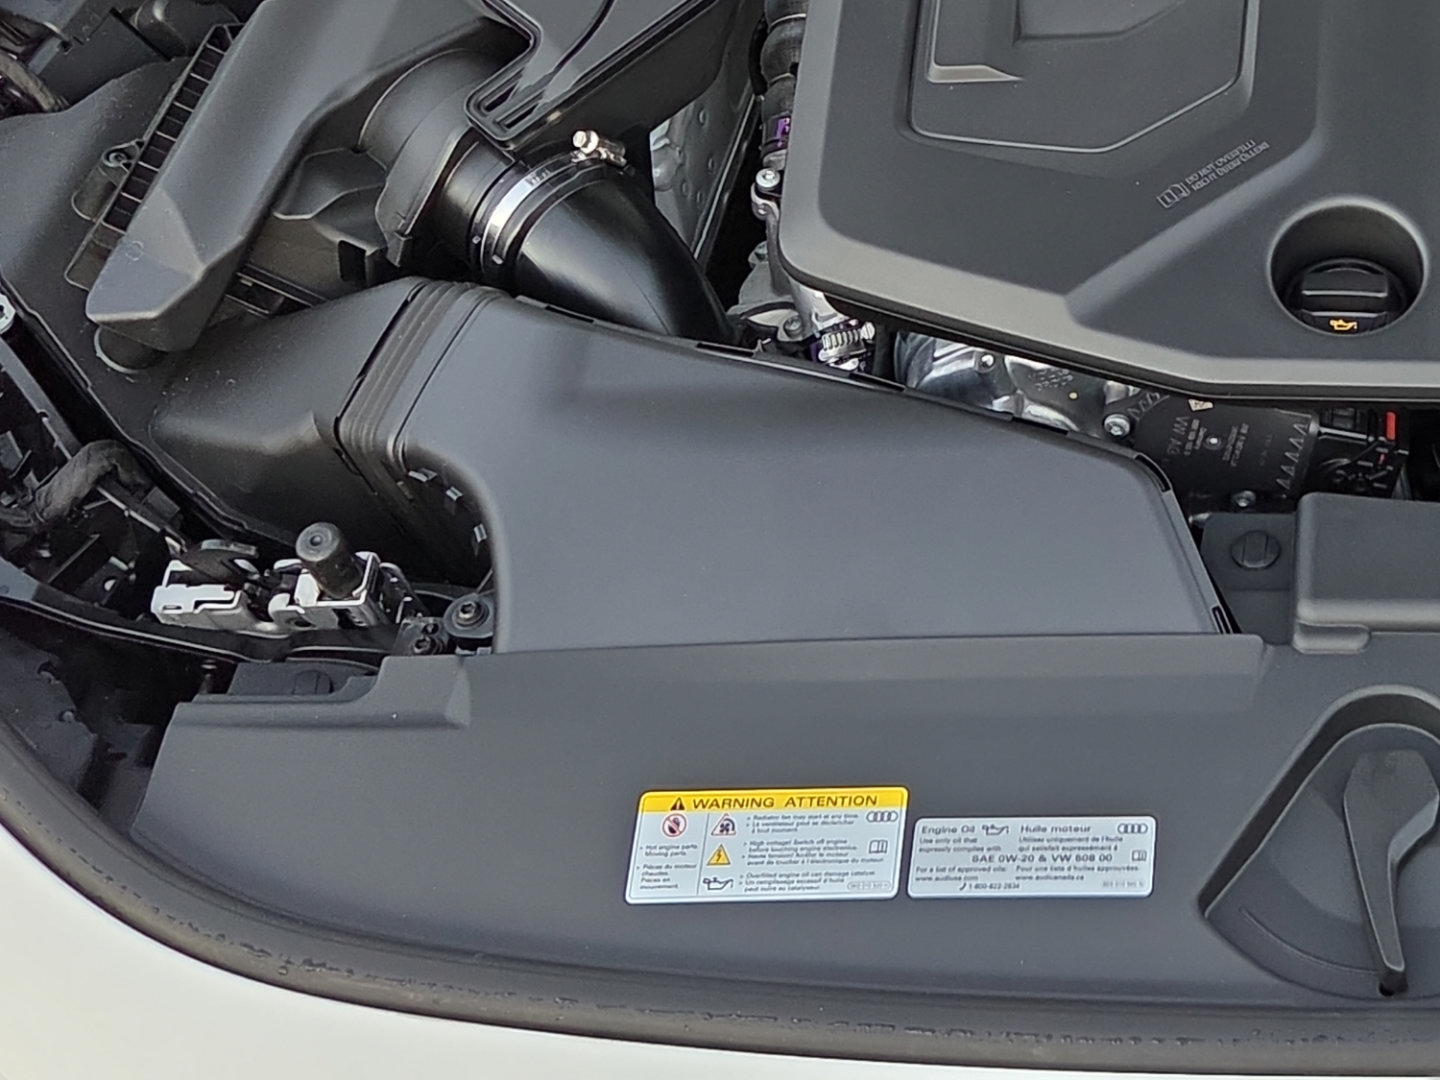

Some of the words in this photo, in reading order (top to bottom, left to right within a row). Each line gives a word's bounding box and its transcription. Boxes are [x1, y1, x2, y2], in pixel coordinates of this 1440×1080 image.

[692, 797, 774, 810] WARNING
[784, 795, 878, 808] ATTENTION
[922, 826, 957, 835] Engine
[961, 825, 975, 833] Oil
[1021, 825, 1047, 833] Huile
[1051, 825, 1091, 833] moteur
[1038, 854, 1047, 862] &
